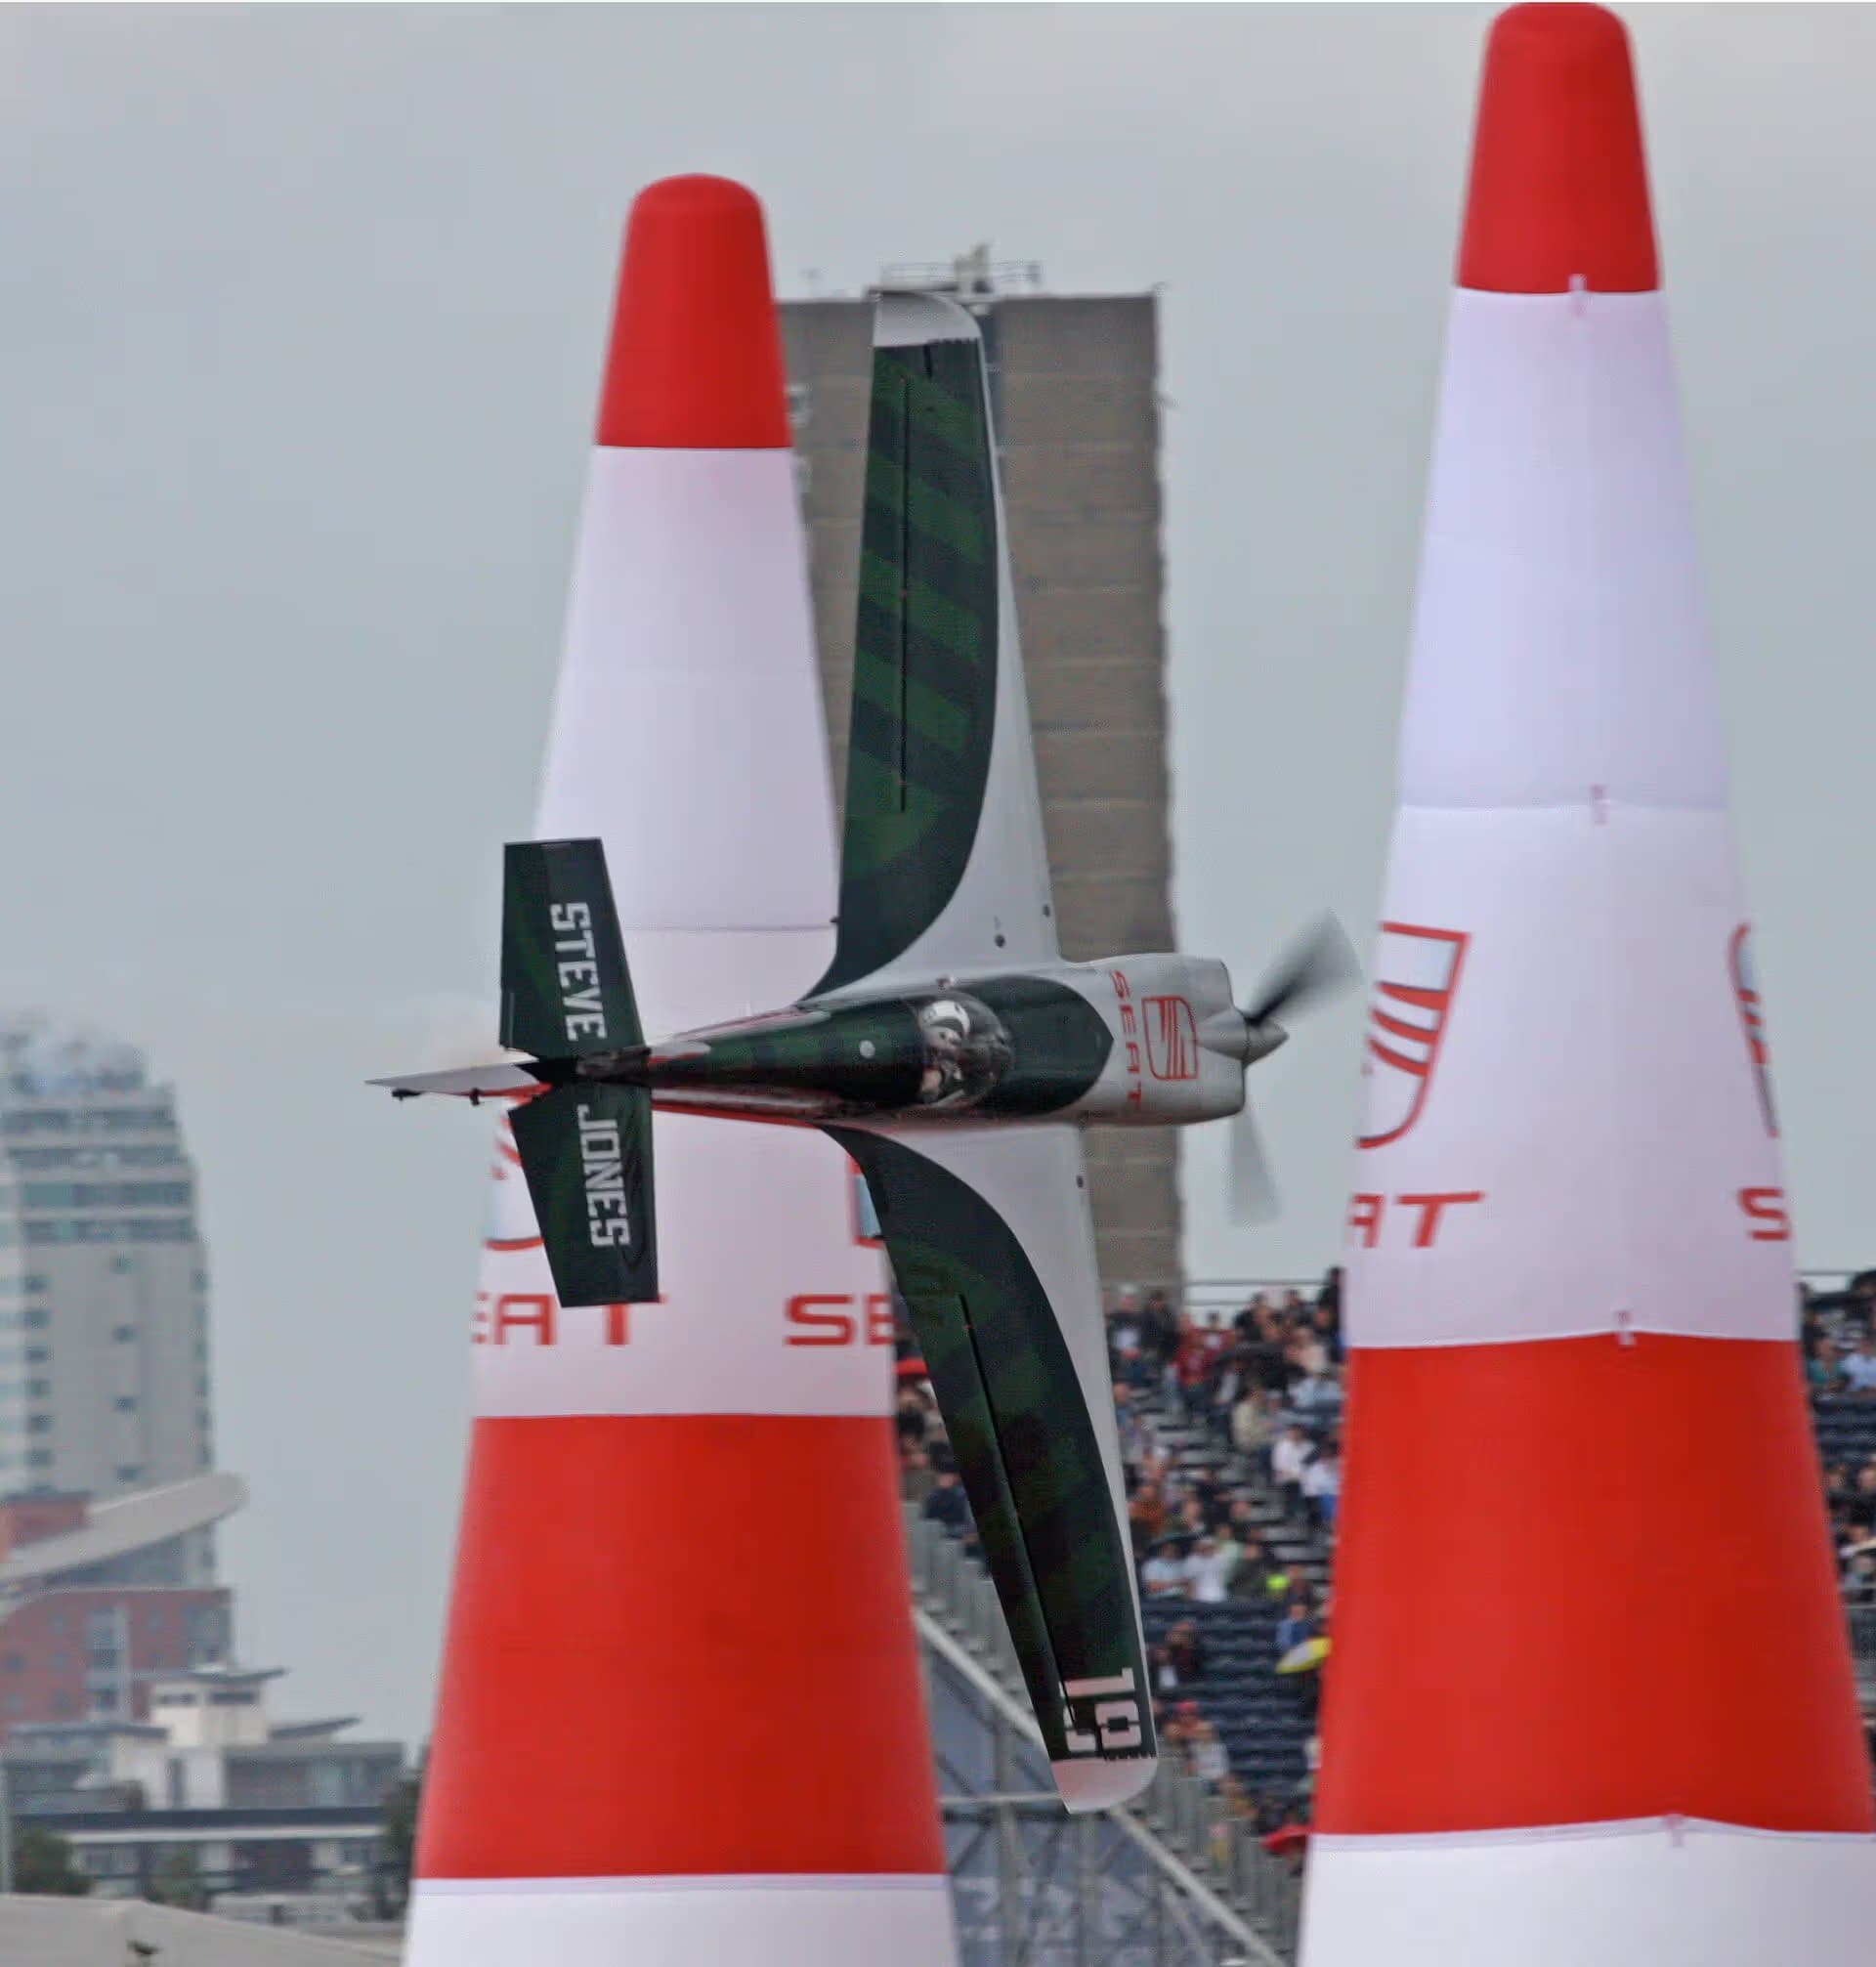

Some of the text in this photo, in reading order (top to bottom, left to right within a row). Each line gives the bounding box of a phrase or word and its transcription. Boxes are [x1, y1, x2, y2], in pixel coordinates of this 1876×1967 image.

[550, 902, 606, 1042] STEVE
[1110, 969, 1142, 1111] SEAT
[576, 1103, 630, 1248] JONES
